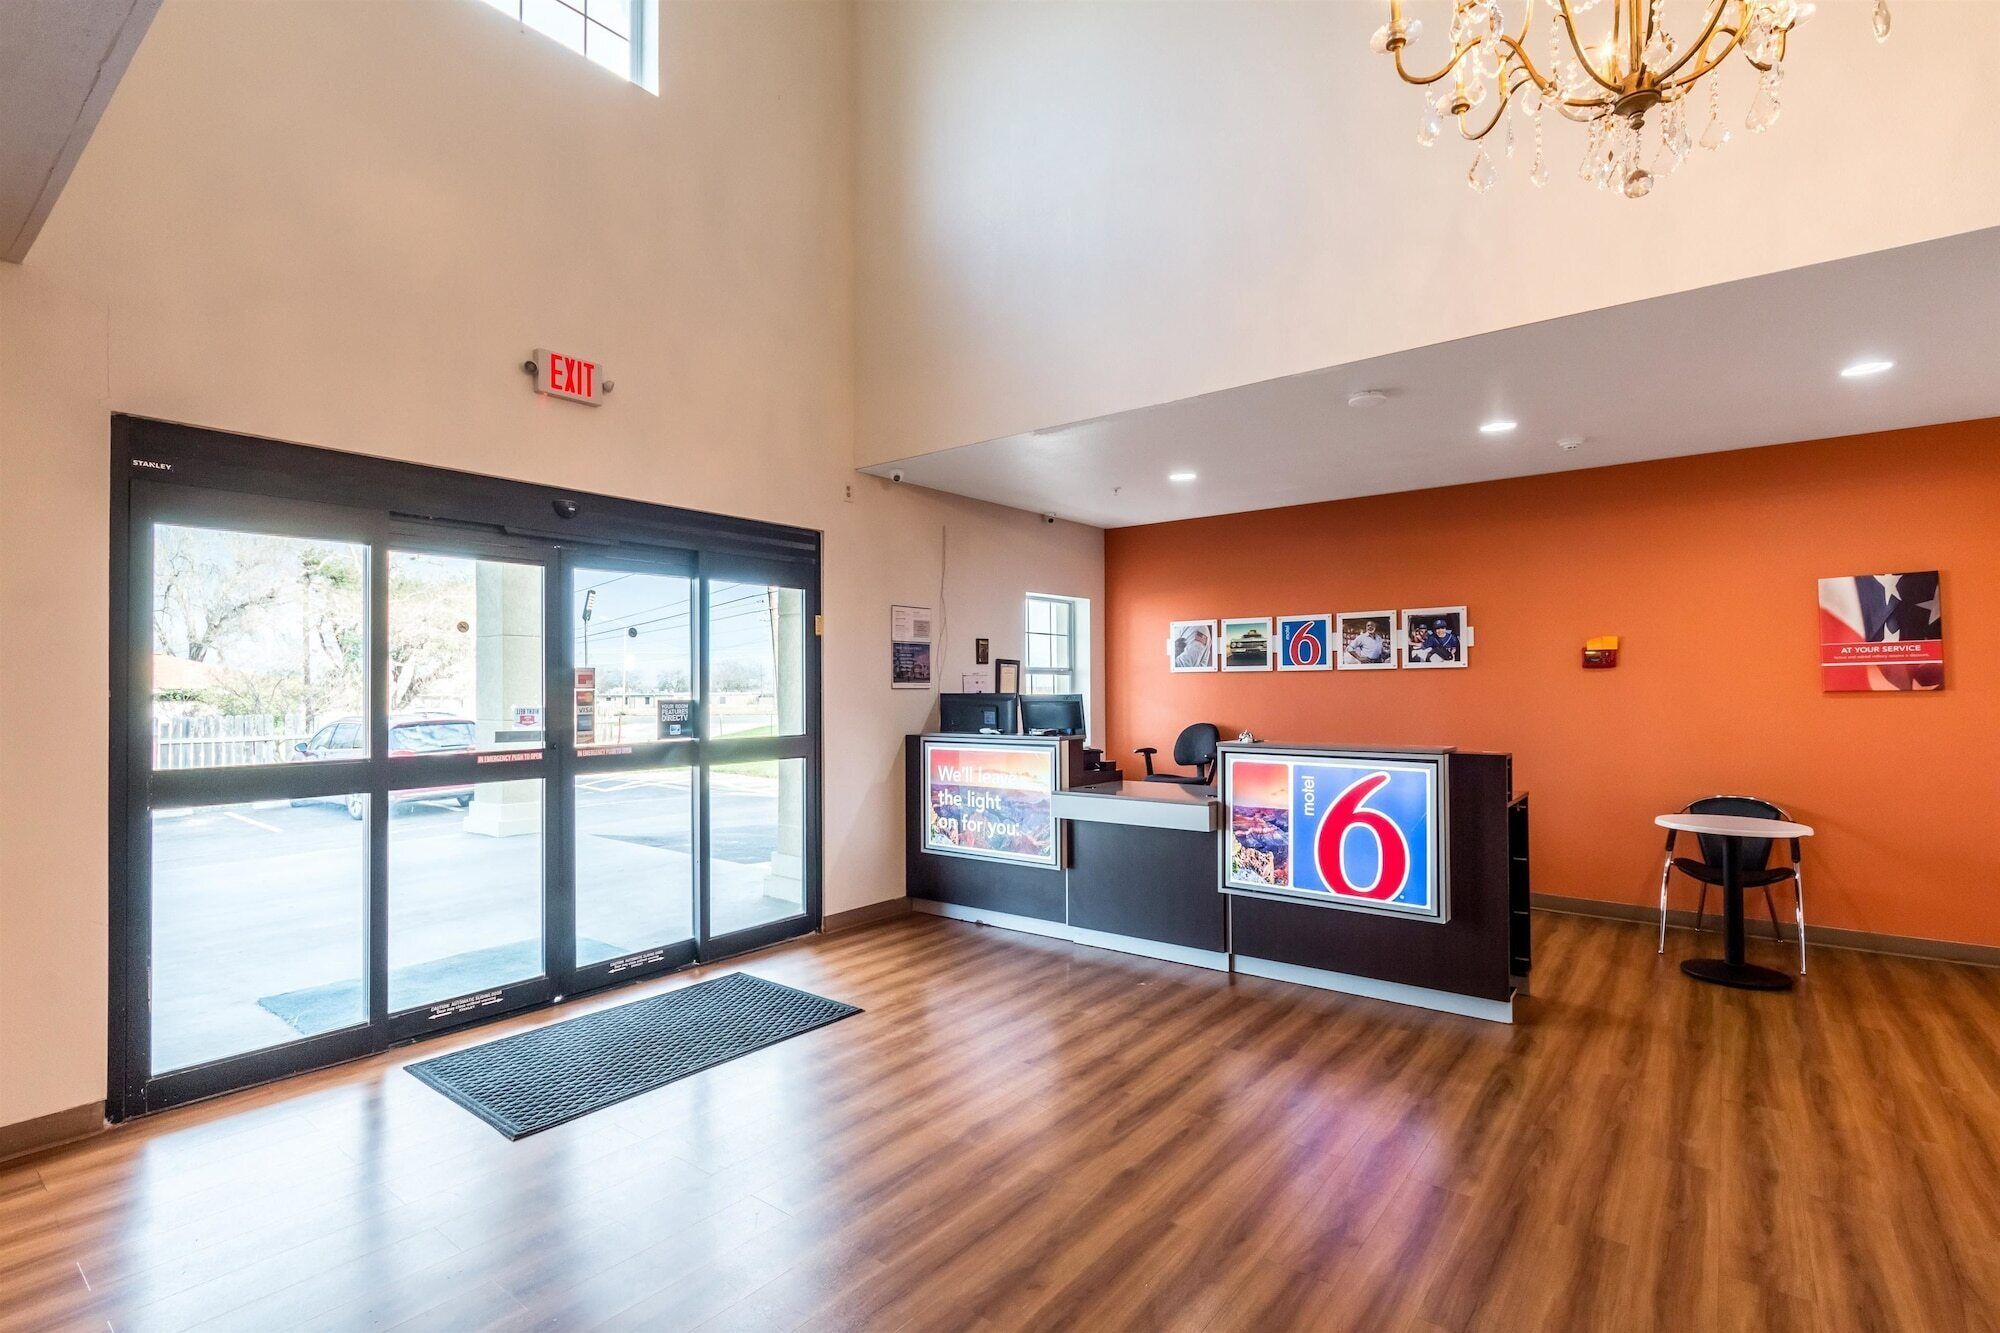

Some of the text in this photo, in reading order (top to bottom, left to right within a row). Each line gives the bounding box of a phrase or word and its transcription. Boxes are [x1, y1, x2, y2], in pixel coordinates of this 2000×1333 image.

[551, 353, 594, 397] EXIT
[132, 459, 172, 470] STANLEY
[1289, 621, 1321, 666] 6
[1882, 644, 1921, 652] SERVICE
[978, 767, 1018, 784] leave
[938, 789, 1002, 812] the light
[1302, 775, 1315, 816] motel
[938, 817, 958, 830] on
[961, 814, 983, 831] for
[1314, 771, 1410, 902] 6
